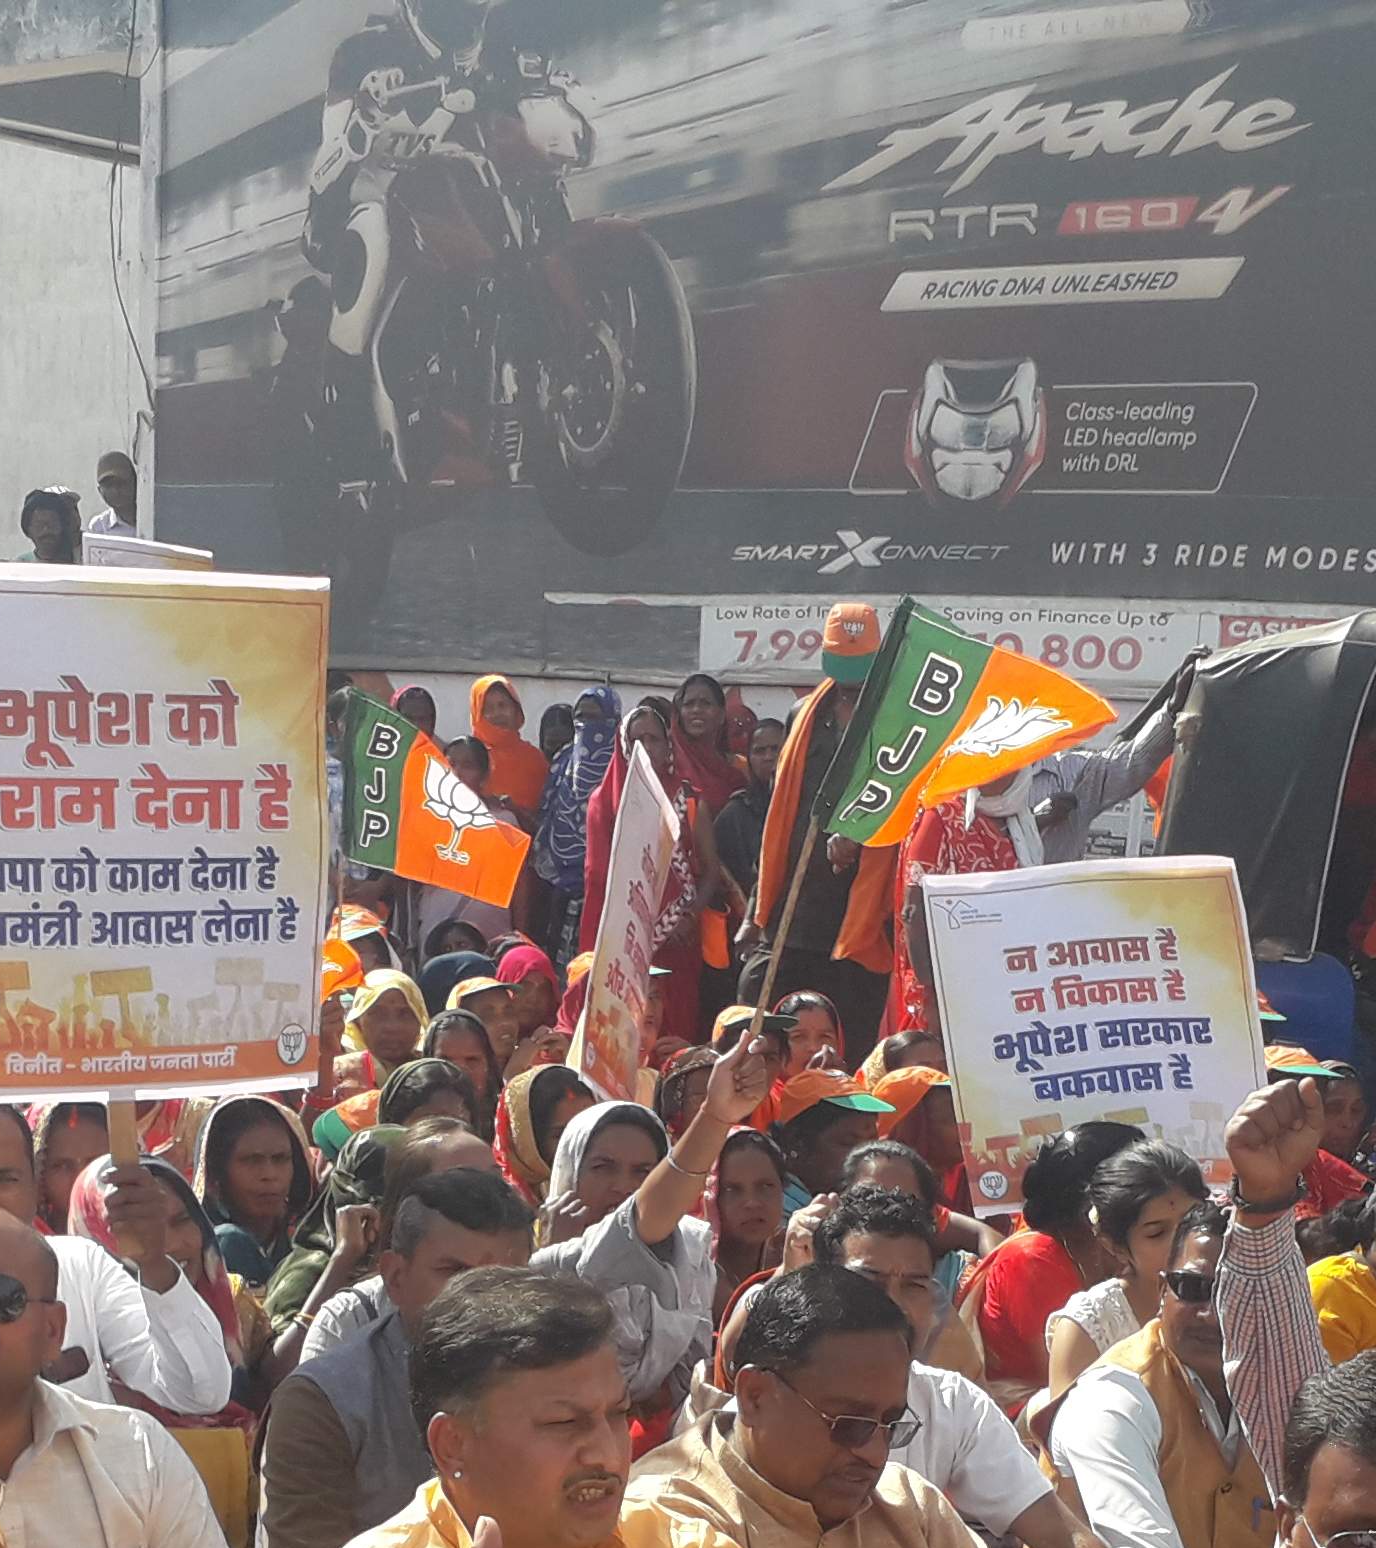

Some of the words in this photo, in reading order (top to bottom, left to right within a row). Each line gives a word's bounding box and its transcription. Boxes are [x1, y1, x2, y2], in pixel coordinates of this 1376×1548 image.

[821, 62, 1314, 198] Apache
[887, 203, 1039, 242] RTR
[1074, 201, 1181, 232] 160
[920, 279, 997, 302] RACING
[1000, 276, 1048, 297] DNA
[1051, 270, 1179, 294] UNLEASHED
[1065, 400, 1196, 425] Class-leading
[1063, 427, 1098, 447] LED
[1101, 426, 1197, 450] headlamp
[1062, 452, 1100, 472] with
[1104, 453, 1140, 472] DRL
[1051, 541, 1127, 565] WITH
[1142, 543, 1158, 566] 3
[1174, 544, 1249, 568] RIDE
[715, 607, 749, 621] Low
[752, 606, 792, 621] Rate
[795, 605, 813, 620] of
[943, 607, 1004, 627] Saving
[1010, 611, 1032, 623] on
[1038, 609, 1112, 626] Finance
[1117, 612, 1144, 629] Up
[734, 630, 827, 663] 7.99
[163, 679, 240, 748] को
[839, 652, 964, 823] BJP
[130, 763, 244, 832] देना
[255, 764, 293, 832] है
[359, 722, 402, 848] BJP
[50, 847, 102, 896] को
[106, 857, 184, 896] काम
[189, 847, 251, 893] देना
[255, 847, 279, 891] है
[90, 909, 197, 946] आवास
[202, 900, 274, 943] लेना
[277, 897, 300, 942] है
[1003, 944, 1039, 973] न
[1048, 936, 1152, 967] आवास
[1155, 928, 1179, 962] है
[1011, 988, 1046, 1014] न
[1052, 975, 1158, 1011] विकास
[1163, 969, 1187, 1001] है
[6, 1052, 62, 1075] विनीत
[81, 1050, 146, 1073] भारतीय
[149, 1054, 198, 1070] जनता
[201, 1045, 238, 1068] पार्टी
[993, 1020, 1088, 1073] भूपेश
[1095, 1017, 1214, 1049] सरकार
[1031, 1061, 1164, 1102] बकवास
[1169, 1053, 1194, 1091] है
